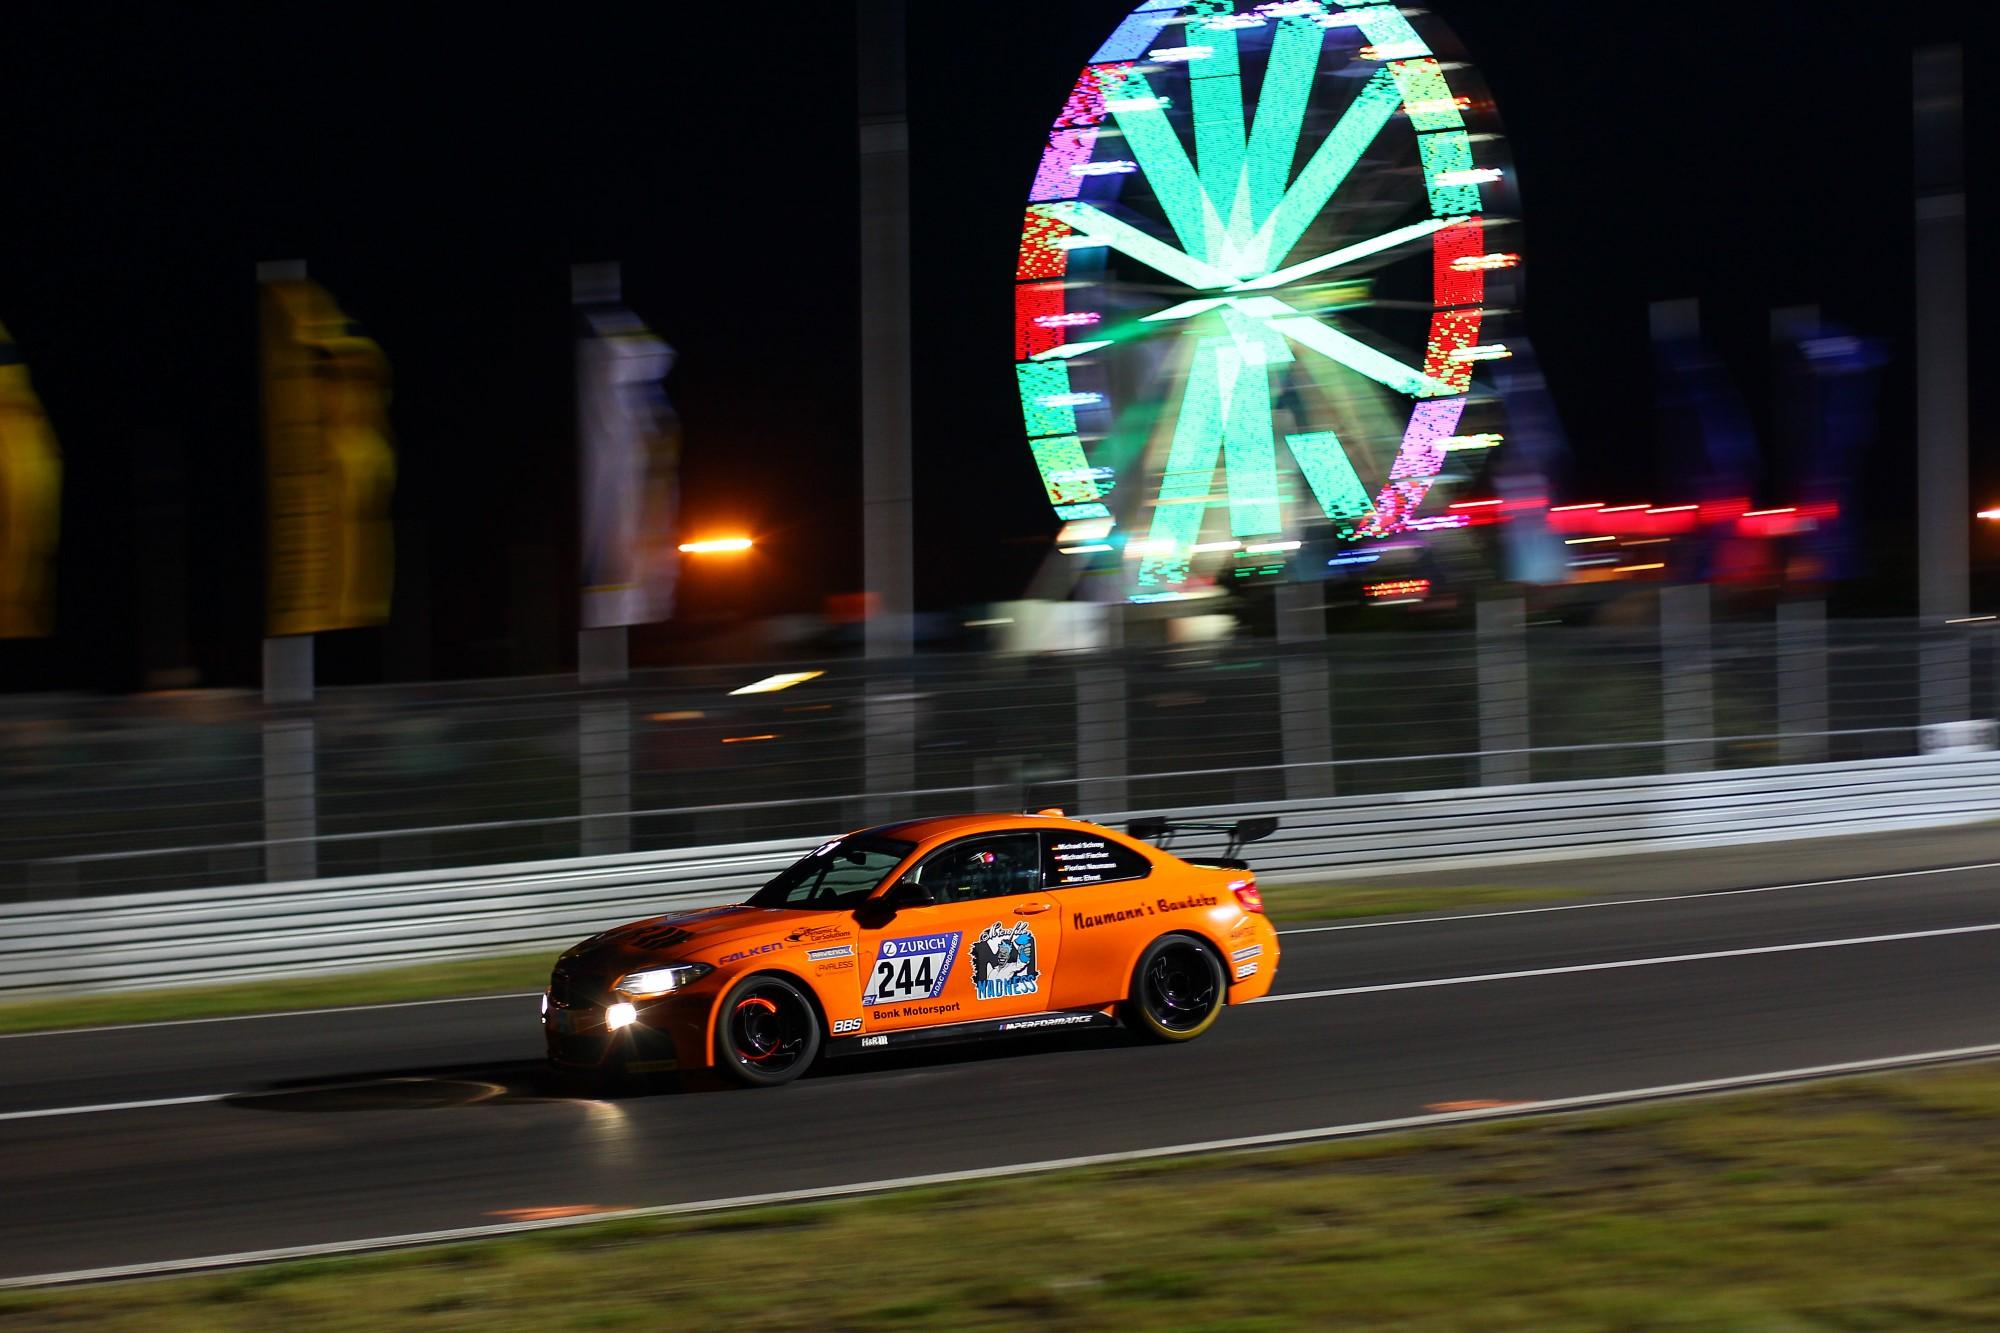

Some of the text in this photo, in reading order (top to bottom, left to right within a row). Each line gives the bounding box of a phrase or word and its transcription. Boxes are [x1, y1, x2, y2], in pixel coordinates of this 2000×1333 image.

[1074, 902, 1155, 930] Naumann's
[719, 942, 783, 965] FALKEN
[898, 938, 946, 953] ZURICH
[933, 933, 959, 997] ADAC NORDRHEIN
[878, 957, 933, 998] 244
[977, 974, 1036, 999] MADNESS
[873, 1002, 960, 1020] Bonk Motorsport
[833, 1018, 861, 1033] BBS
